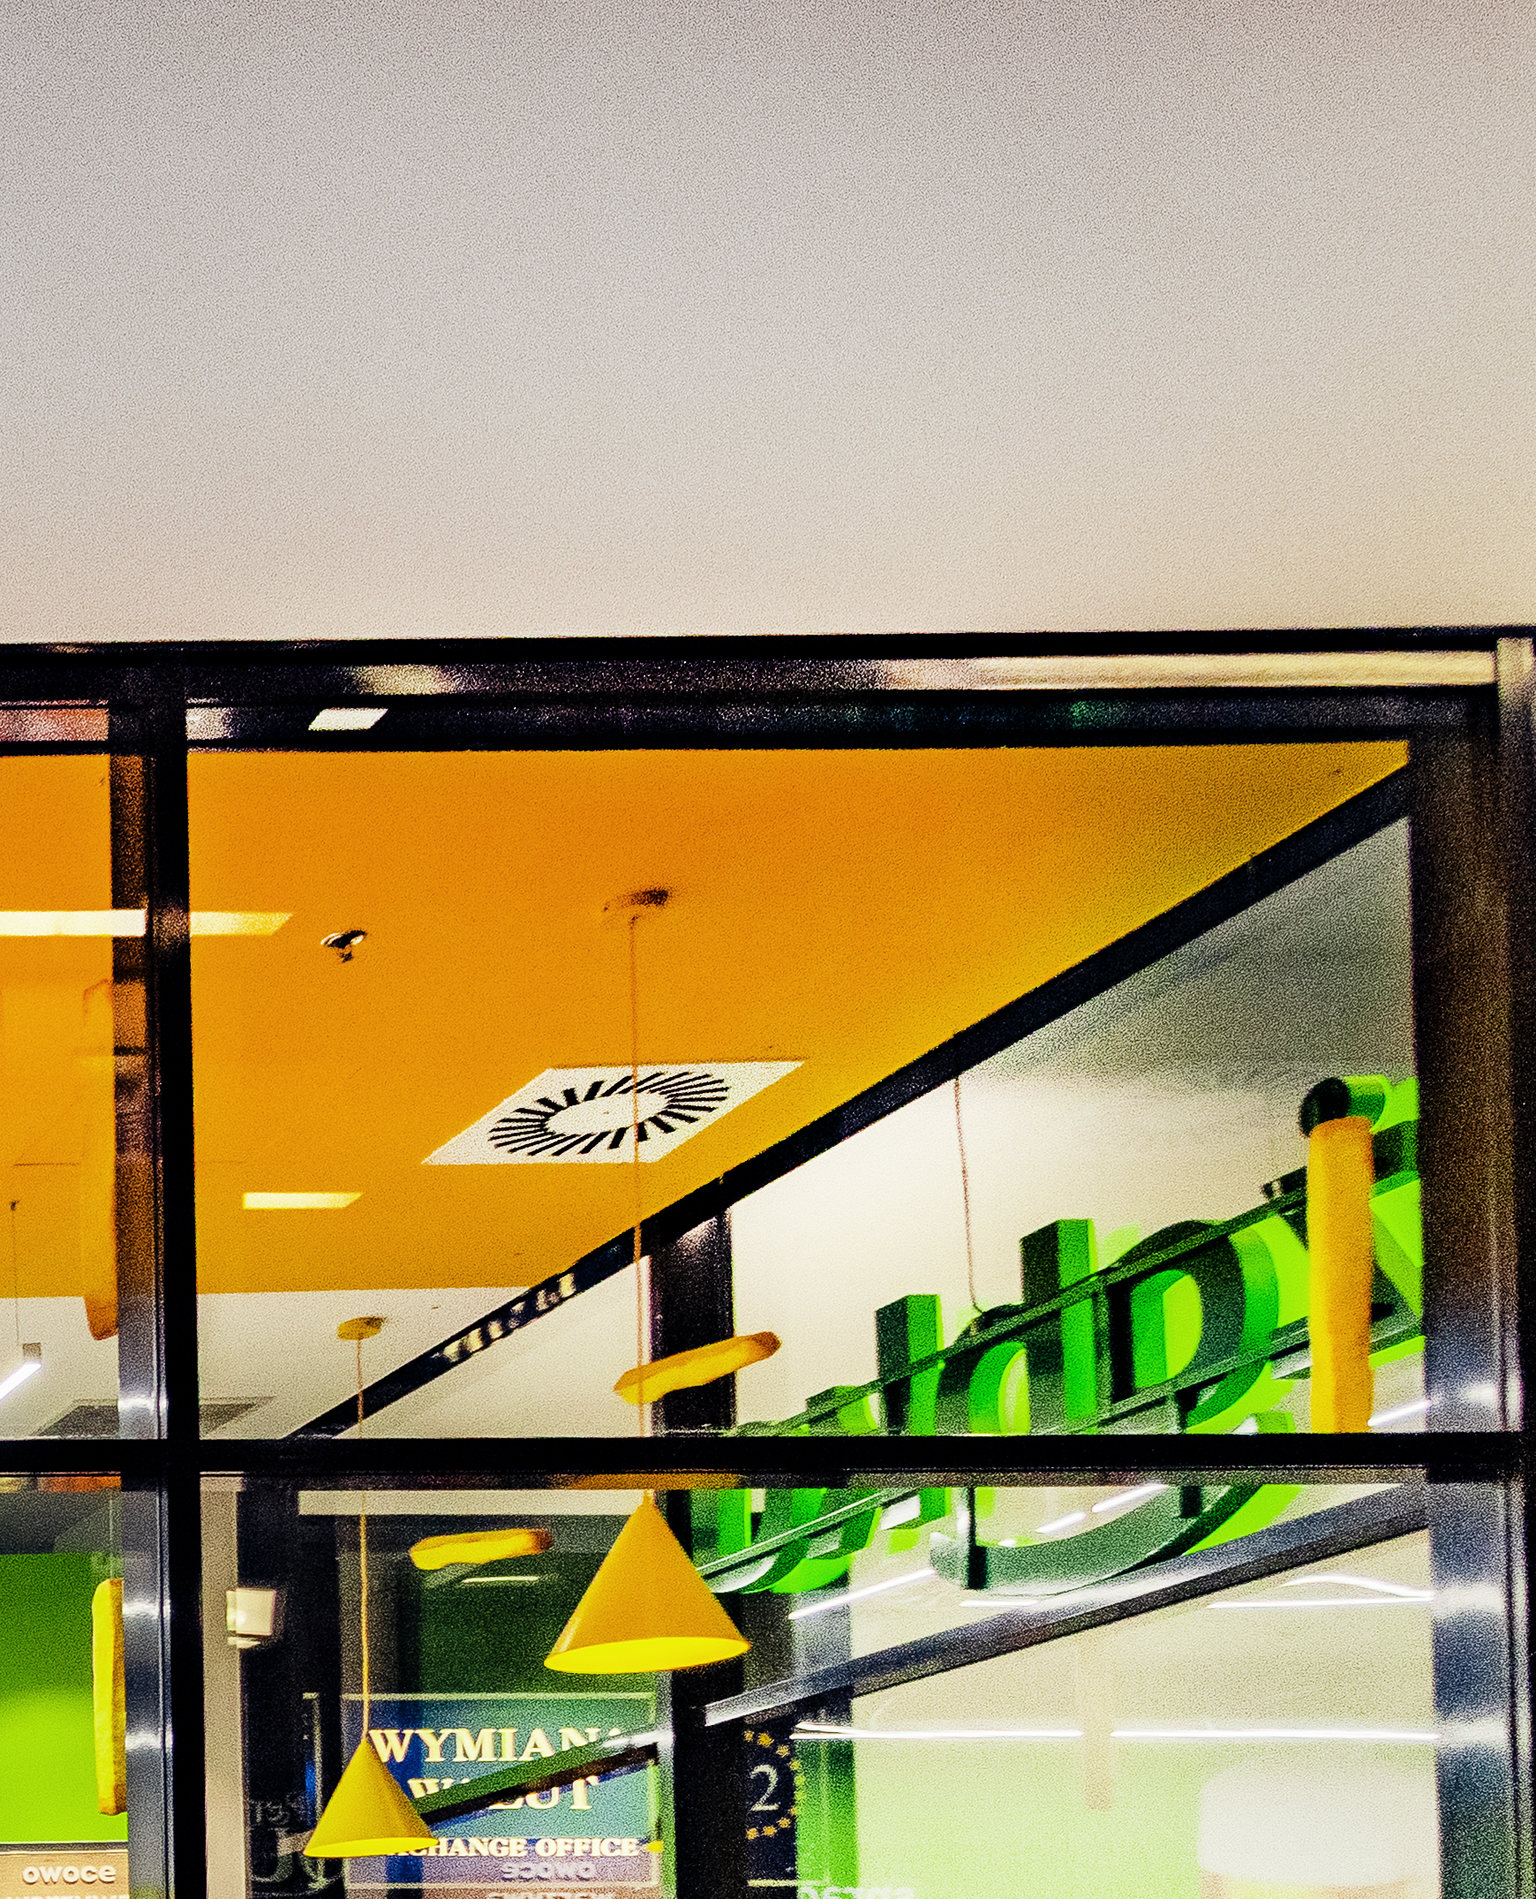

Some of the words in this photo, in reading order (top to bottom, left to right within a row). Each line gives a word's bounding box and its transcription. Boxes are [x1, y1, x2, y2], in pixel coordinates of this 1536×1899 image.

[369, 1726, 627, 1764] WYMIAN
[398, 1837, 527, 1859] CHANGE
[535, 1837, 639, 1859] OFFICE
[22, 1864, 116, 1884] owoce
